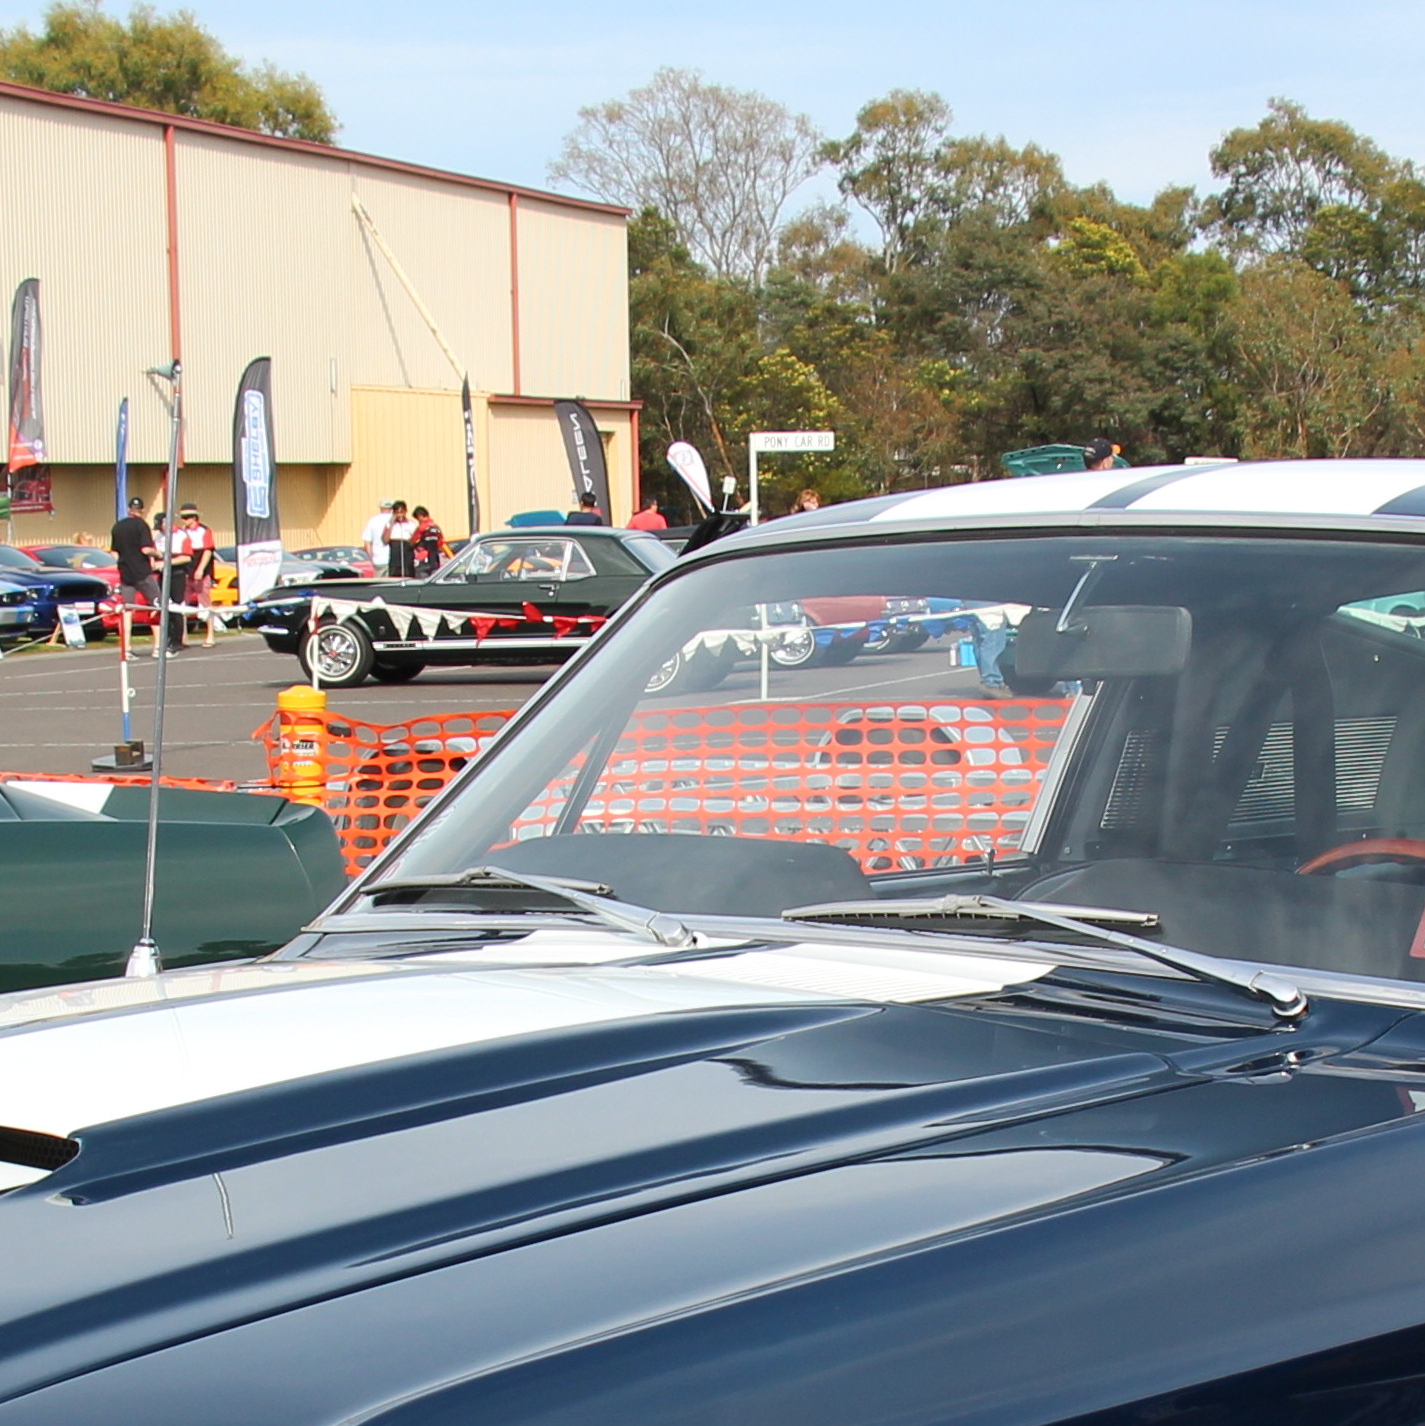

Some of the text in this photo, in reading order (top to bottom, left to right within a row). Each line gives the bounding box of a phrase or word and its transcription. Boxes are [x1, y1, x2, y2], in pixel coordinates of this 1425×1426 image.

[251, 401, 264, 481] SHELBY
[764, 435, 831, 448] PONY CAR RD
